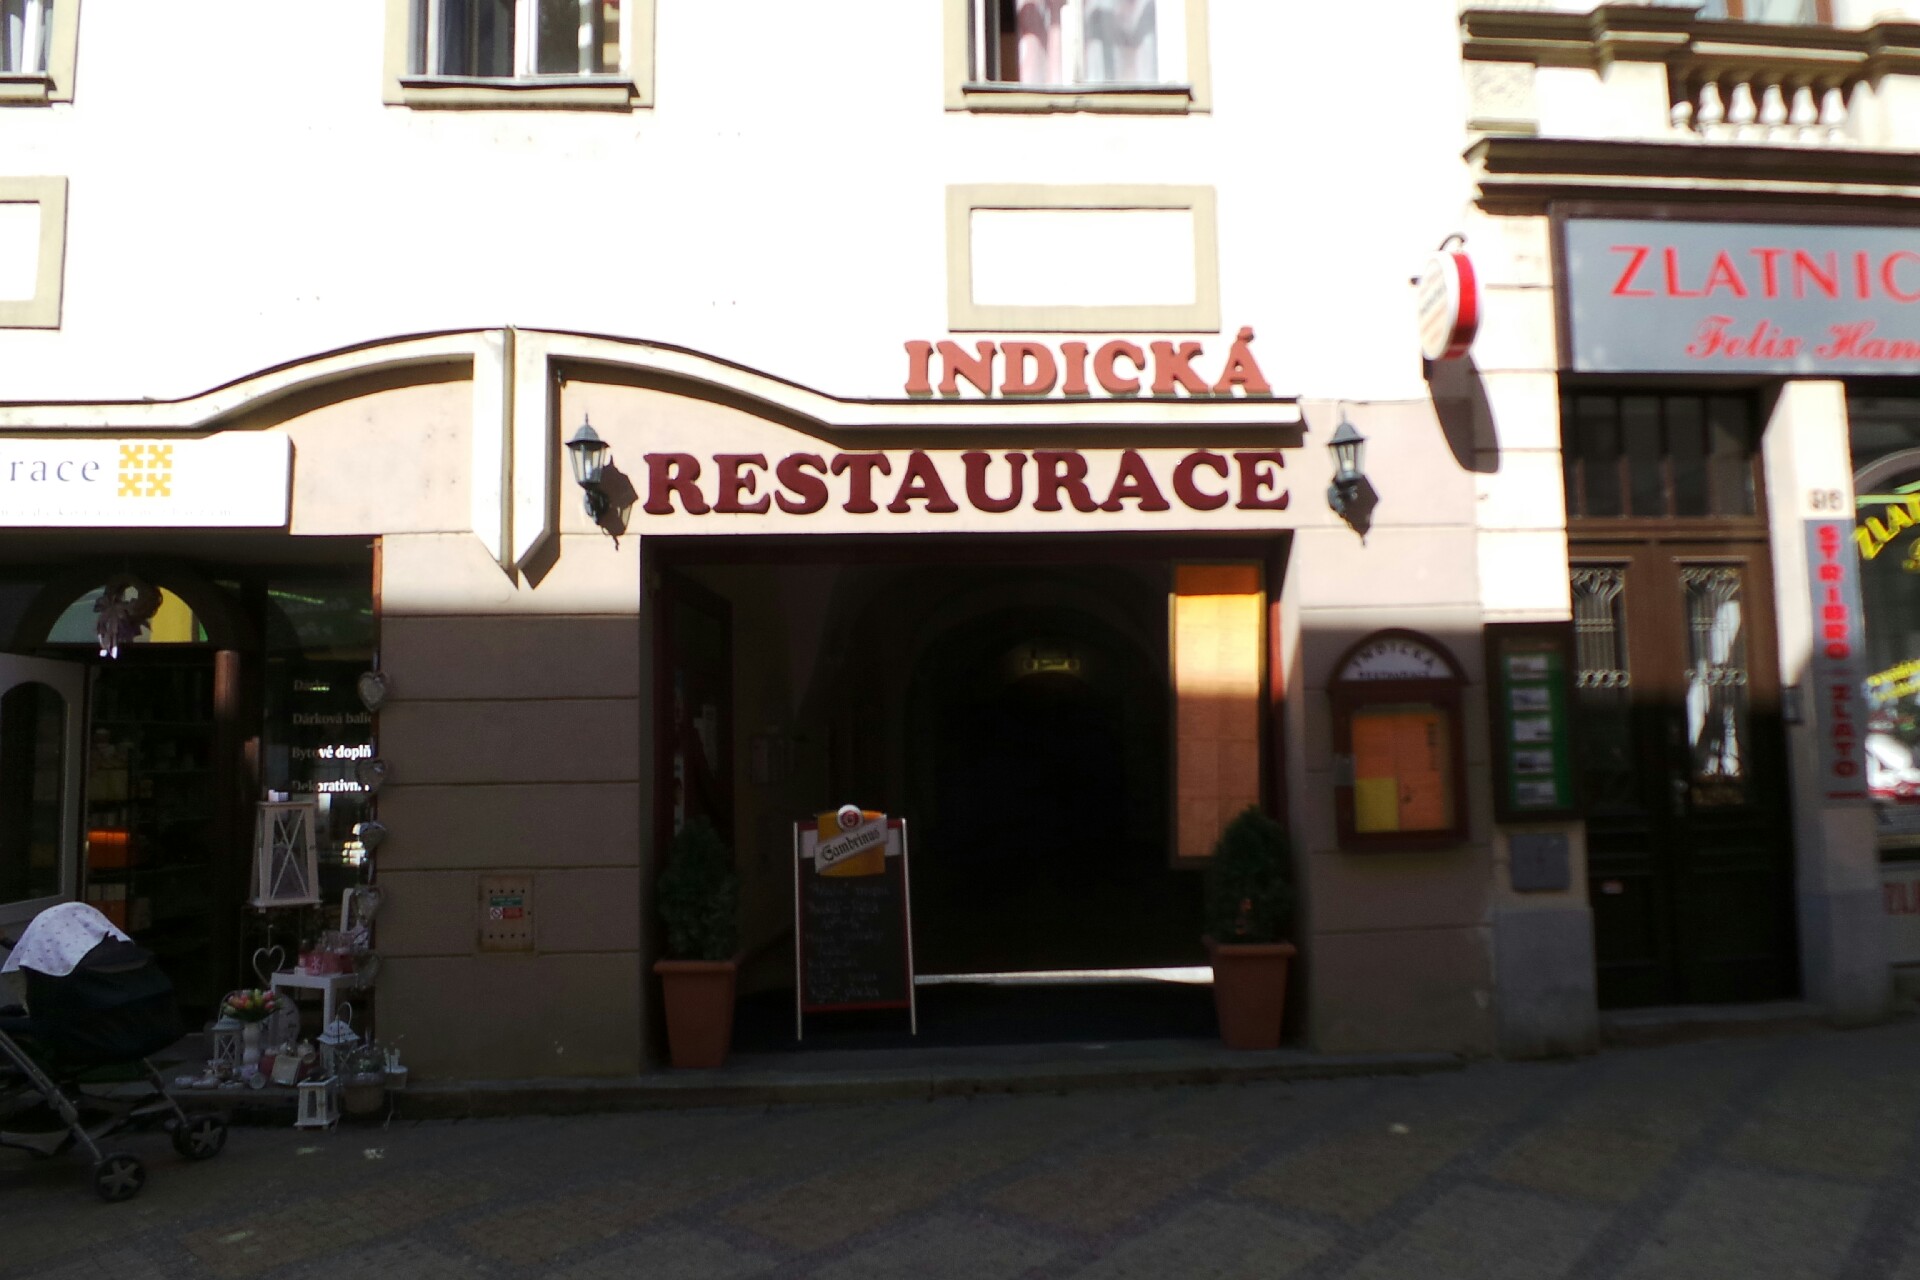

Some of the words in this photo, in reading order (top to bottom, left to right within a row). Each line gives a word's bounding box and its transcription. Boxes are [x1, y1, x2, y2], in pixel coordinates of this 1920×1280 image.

[904, 327, 1270, 396] INDICKÁ
[1685, 314, 1803, 360] Felix
[643, 450, 1290, 514] RESTAURACE
[822, 828, 880, 862] Gambrinus
